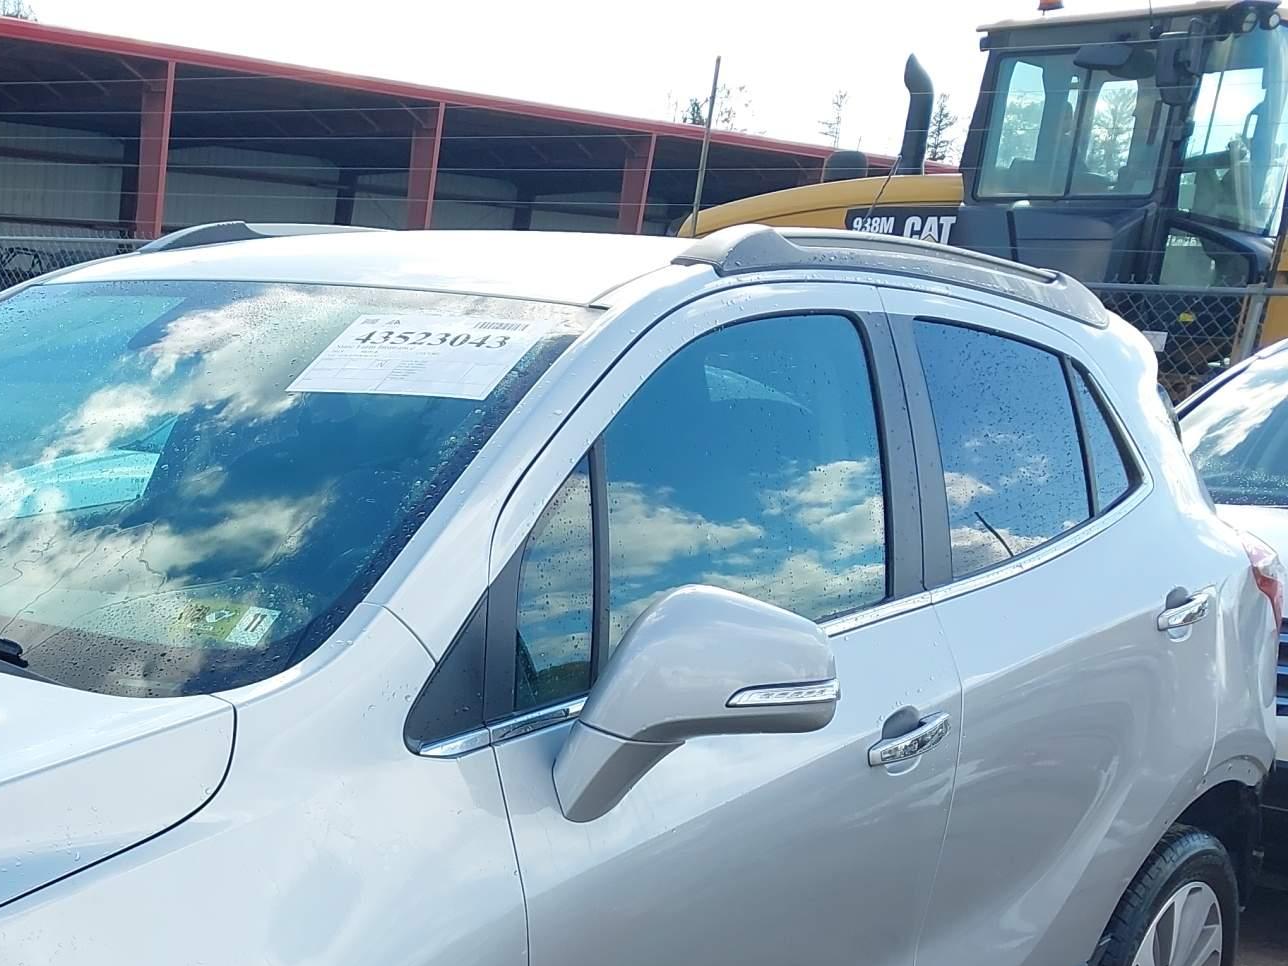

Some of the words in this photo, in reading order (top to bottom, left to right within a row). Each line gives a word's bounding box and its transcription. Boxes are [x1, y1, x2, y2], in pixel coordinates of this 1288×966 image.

[852, 216, 895, 234] 938M
[903, 215, 957, 245] CAT
[355, 330, 510, 349] 43523043
